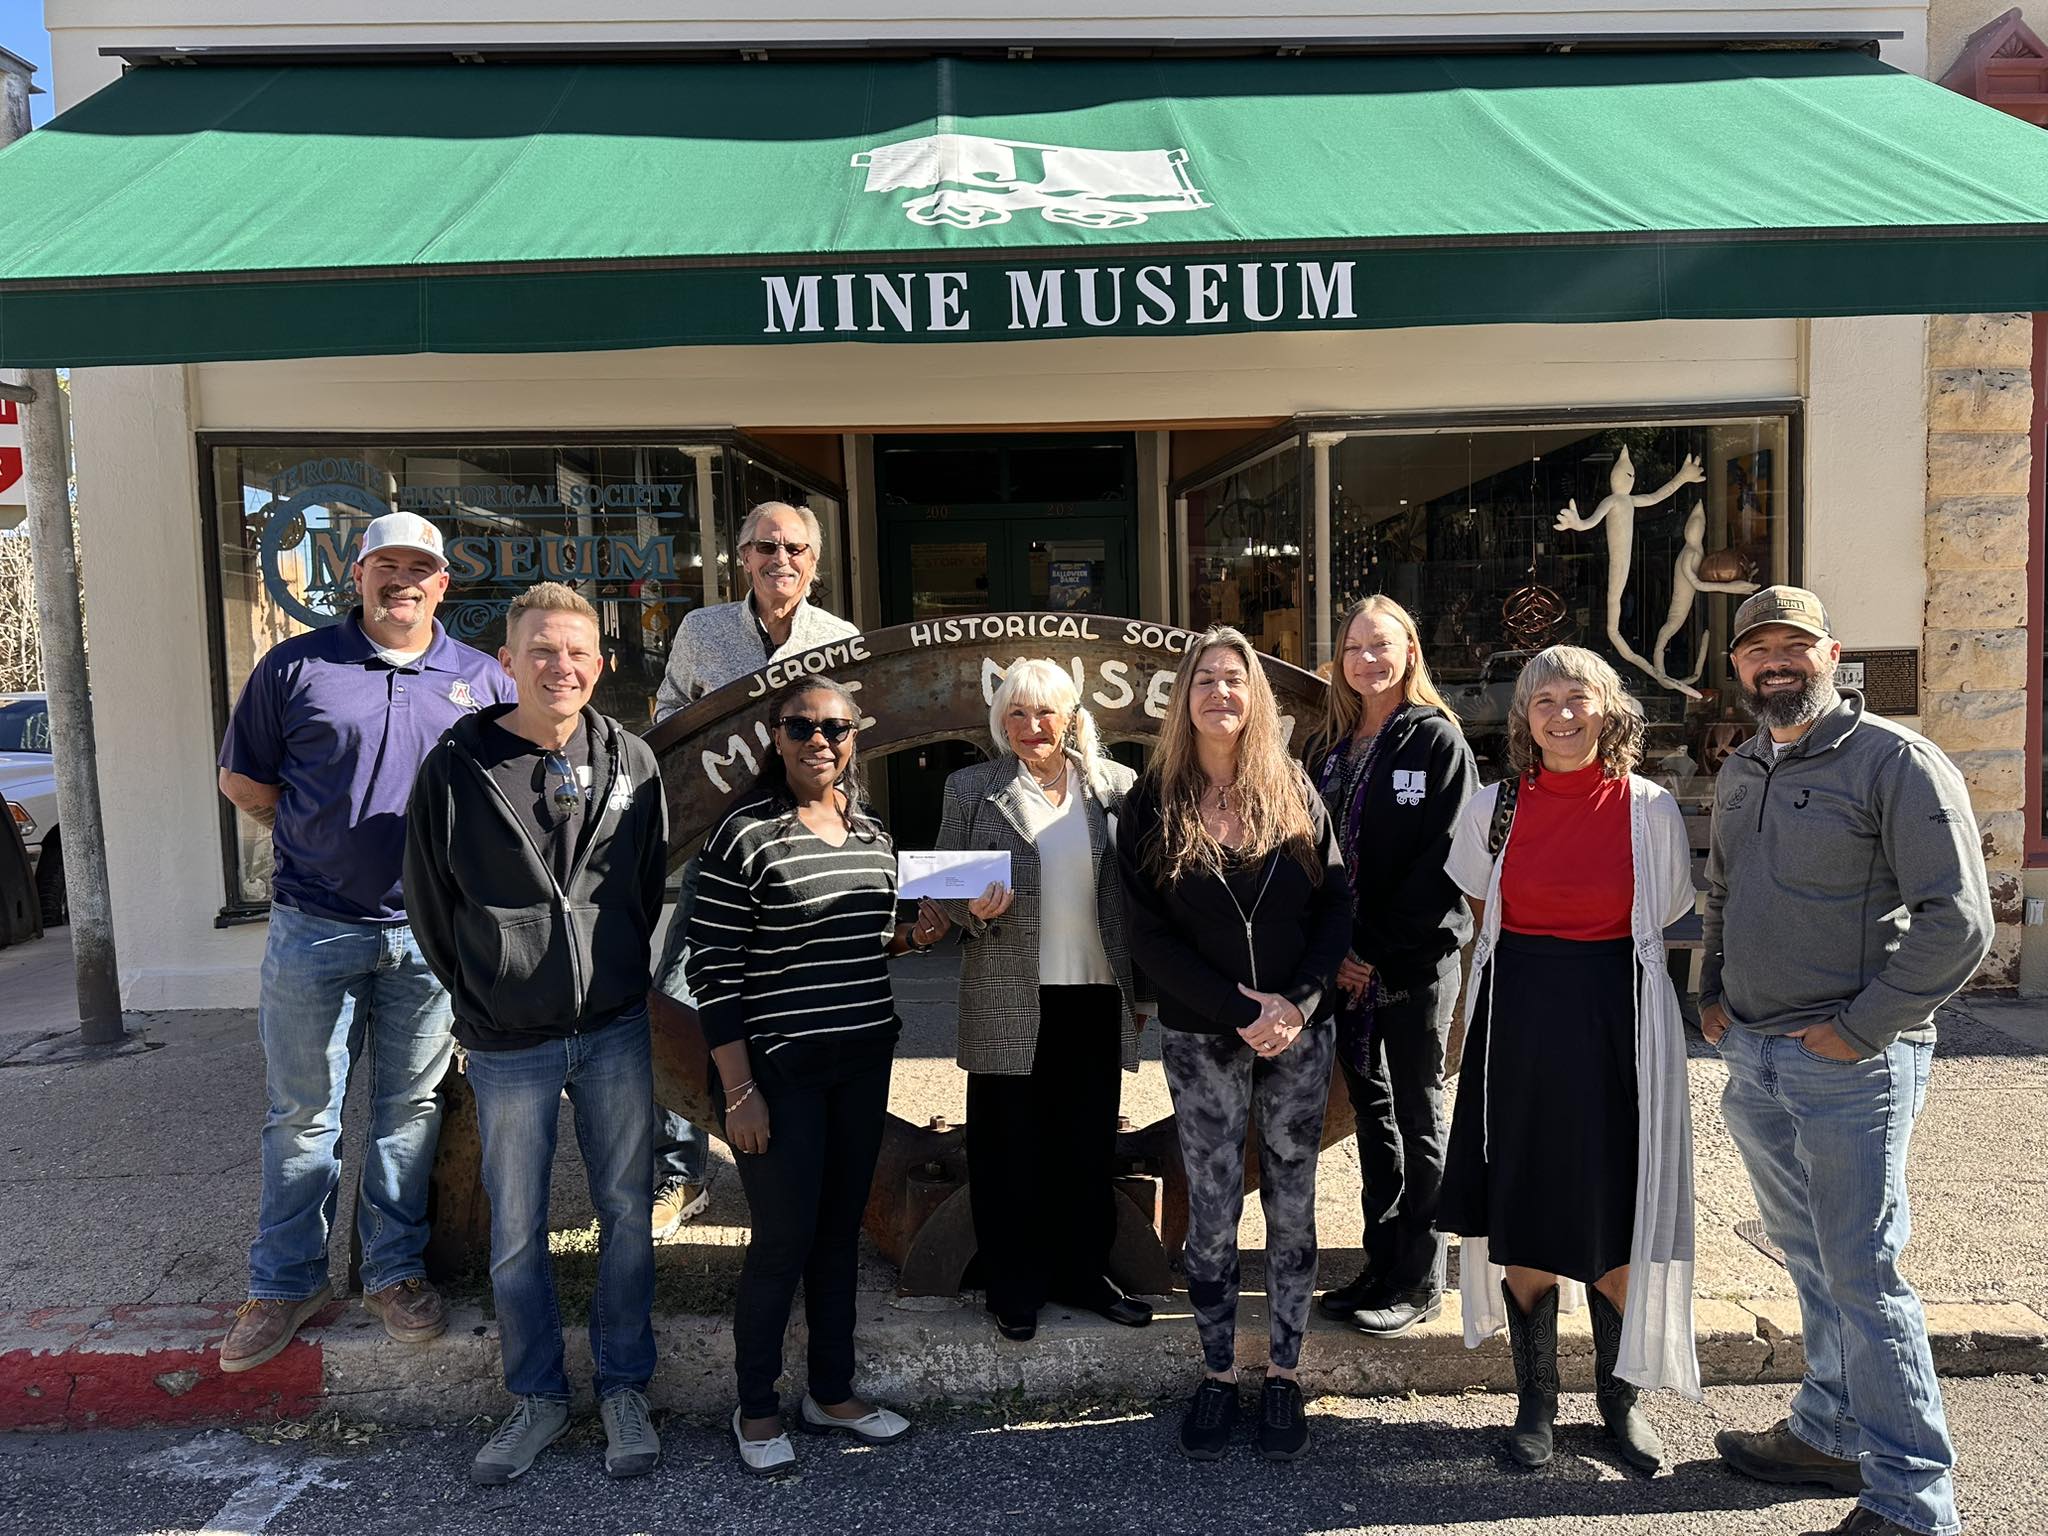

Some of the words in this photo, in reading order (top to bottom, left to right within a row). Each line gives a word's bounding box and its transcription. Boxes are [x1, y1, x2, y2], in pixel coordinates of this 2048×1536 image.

[761, 272, 970, 334] MINE
[1006, 261, 1358, 331] MUSEUM
[267, 457, 385, 504] JEROME
[401, 485, 562, 508] HISTORICAL
[570, 484, 683, 507] SOCIETY
[304, 527, 679, 592] MSEUM
[748, 636, 872, 699] JEROME
[910, 614, 1100, 647] HISTORICAL
[1122, 622, 1195, 653] SOCI
[1793, 789, 1811, 810] J
